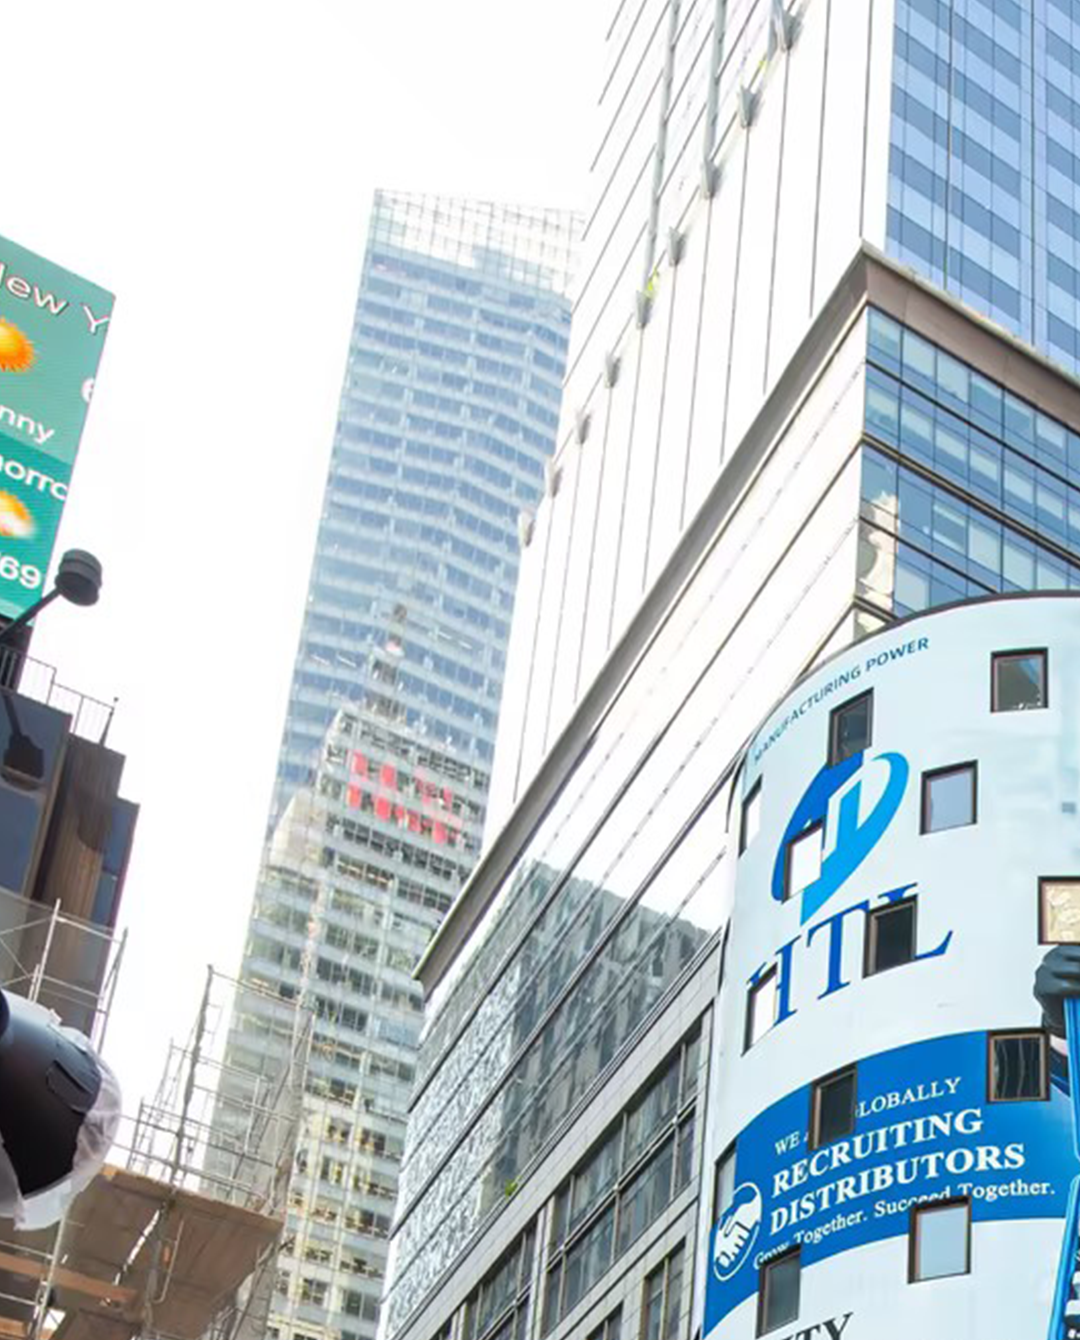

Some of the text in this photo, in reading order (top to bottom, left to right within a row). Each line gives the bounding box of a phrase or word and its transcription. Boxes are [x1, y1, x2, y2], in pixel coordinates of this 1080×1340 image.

[0, 263, 68, 316] ew
[755, 637, 929, 763] MANUFACTURING POWER
[771, 1108, 983, 1198] RECRUITING
[774, 1076, 961, 1155] WE LOBALLY
[769, 1143, 1026, 1237] DISTRIBUTORS
[794, 1210, 867, 1245] Together.
[957, 1180, 1055, 1201] Together.
